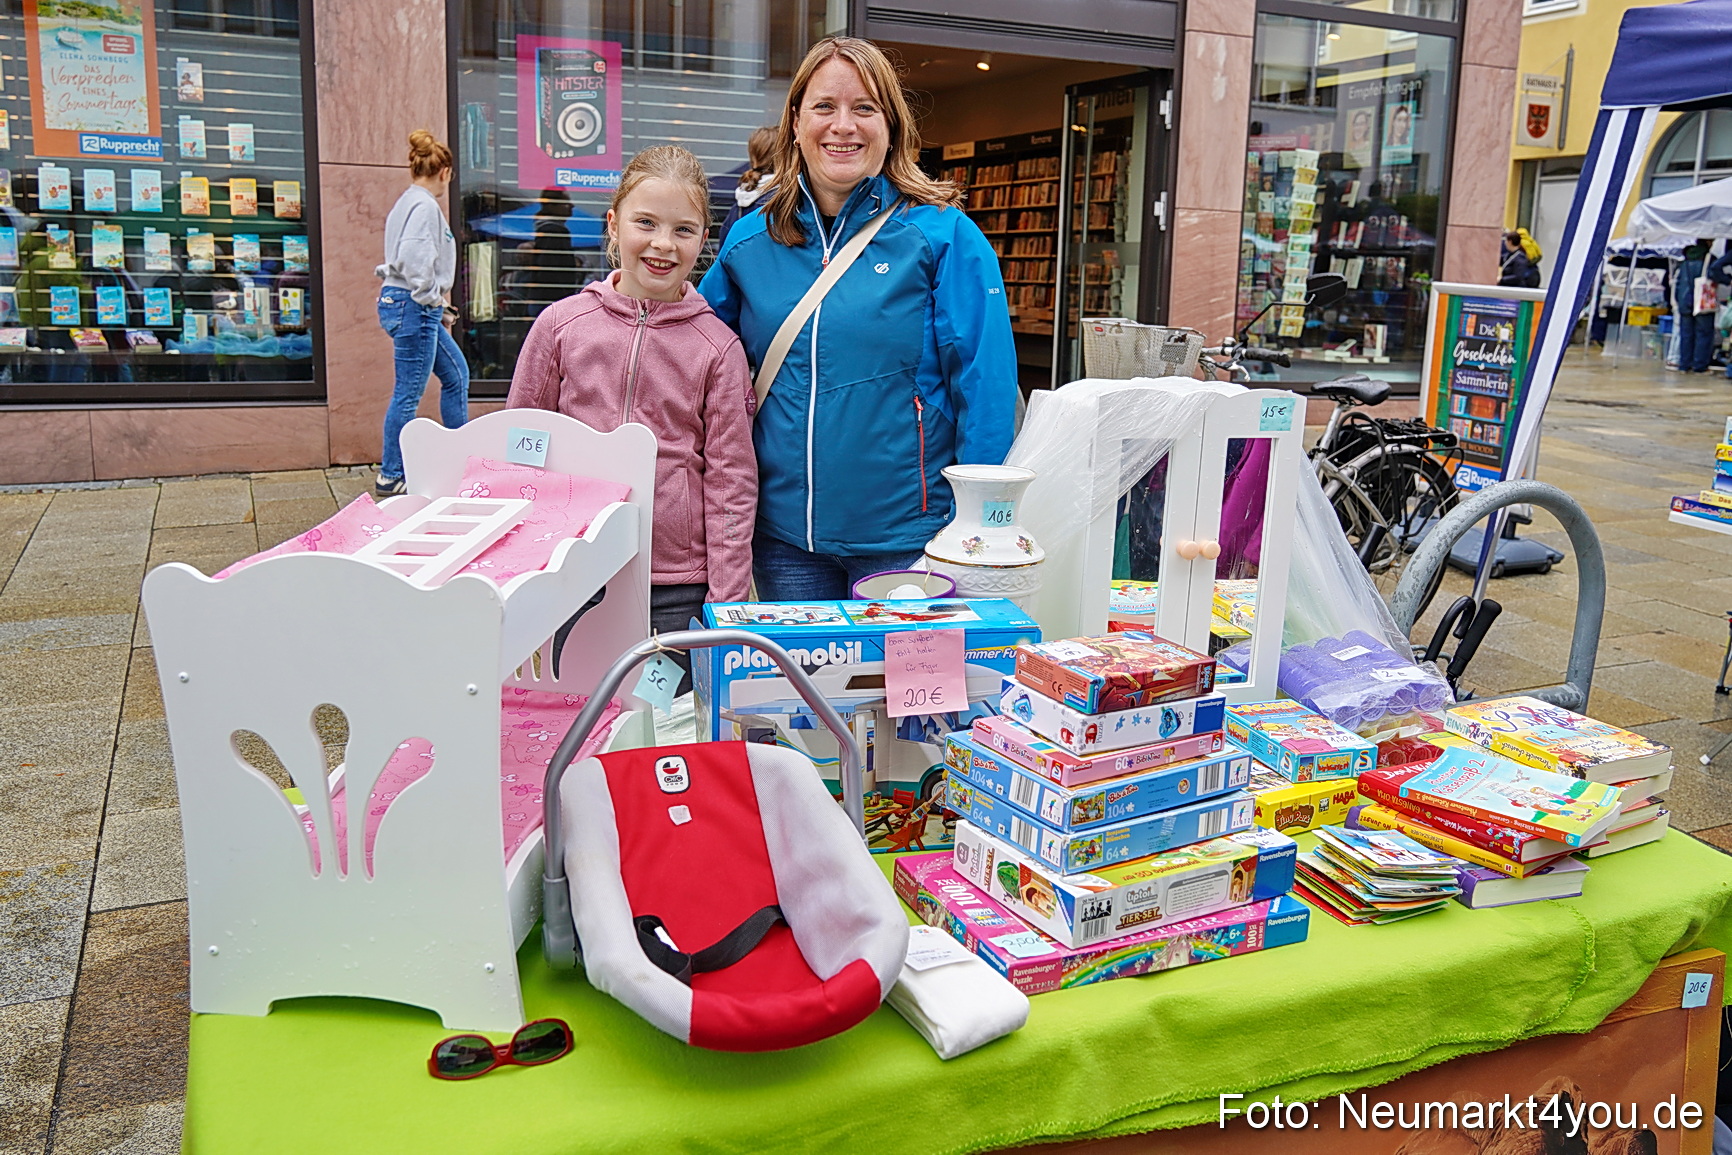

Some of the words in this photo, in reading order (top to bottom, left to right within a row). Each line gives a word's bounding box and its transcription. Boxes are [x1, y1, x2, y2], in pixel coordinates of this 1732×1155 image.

[60, 52, 84, 60] ELENA
[87, 54, 129, 64] SONNBERG
[84, 64, 101, 73] DAS
[51, 65, 136, 91] Versprechen
[82, 86, 106, 97] EINES
[1348, 80, 1422, 100] Empfehlungen
[100, 137, 160, 153] Rupprecht
[571, 172, 620, 186] Rupprecht
[1478, 323, 1497, 337] Die
[1453, 341, 1518, 367] Geschichten
[1455, 371, 1510, 391] Sammlerin
[965, 650, 1003, 660] mmer
[1002, 647, 1017, 659] Fu
[992, 732, 1005, 750] 60
[1115, 756, 1129, 771] 60
[971, 769, 986, 786] 104
[1332, 790, 1356, 805] HABA
[1390, 796, 1421, 814] GANGSTA
[972, 808, 984, 822] 64
[1107, 804, 1125, 819] 104
[1106, 848, 1120, 861] 64
[1259, 848, 1296, 863] Ravensburger
[1126, 886, 1151, 903] tiptoi
[1121, 907, 1159, 925] TIER-SET
[1267, 914, 1308, 927] Ravensburger
[1229, 929, 1241, 940] 6+
[1247, 930, 1258, 948] 100
[1013, 963, 1056, 977] Ravensburger
[1012, 975, 1033, 986] Puzzle
